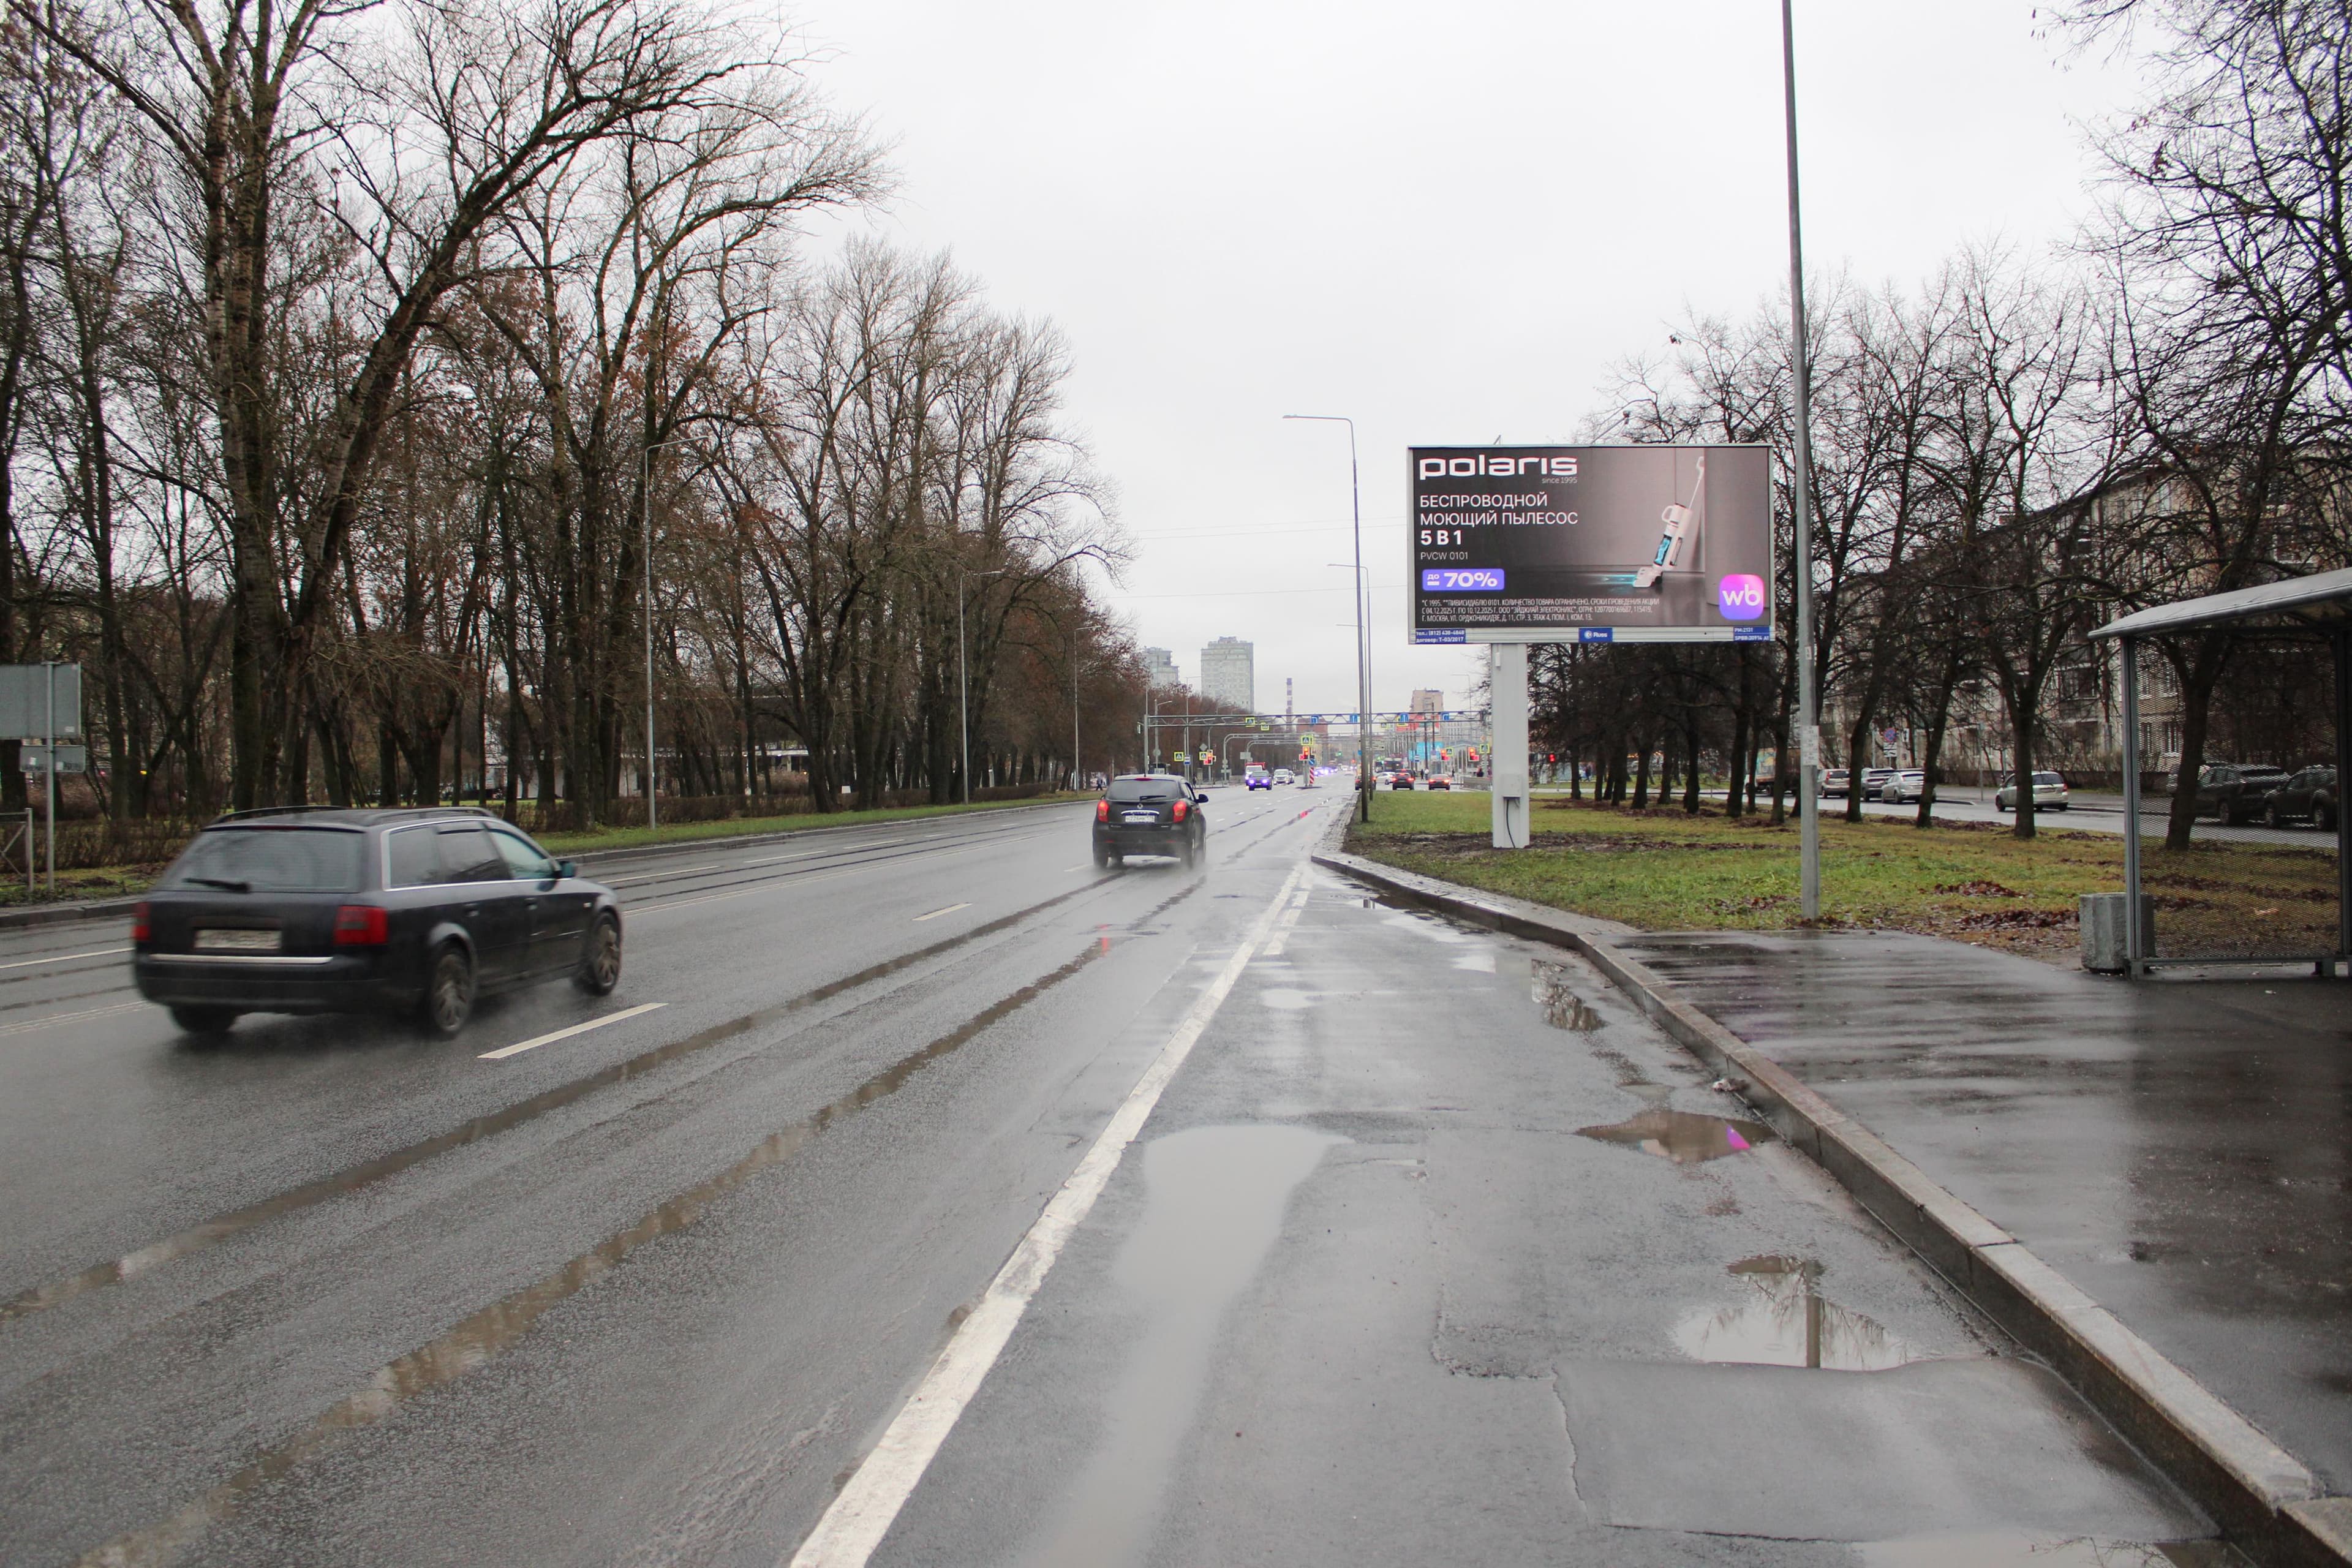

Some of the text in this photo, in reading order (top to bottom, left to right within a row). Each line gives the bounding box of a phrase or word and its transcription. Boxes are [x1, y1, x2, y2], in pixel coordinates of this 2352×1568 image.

[1420, 454, 1578, 480] polaris
[1420, 492, 1548, 509] БЕСПРОВОДНОЙ
[1420, 510, 1578, 527] МОЮЩИЙ ПЫЛЕСОС
[1420, 530, 1432, 545] 5
[1453, 530, 1462, 545] 1
[1449, 551, 1469, 560] 0101
[1722, 583, 1760, 606] wb
